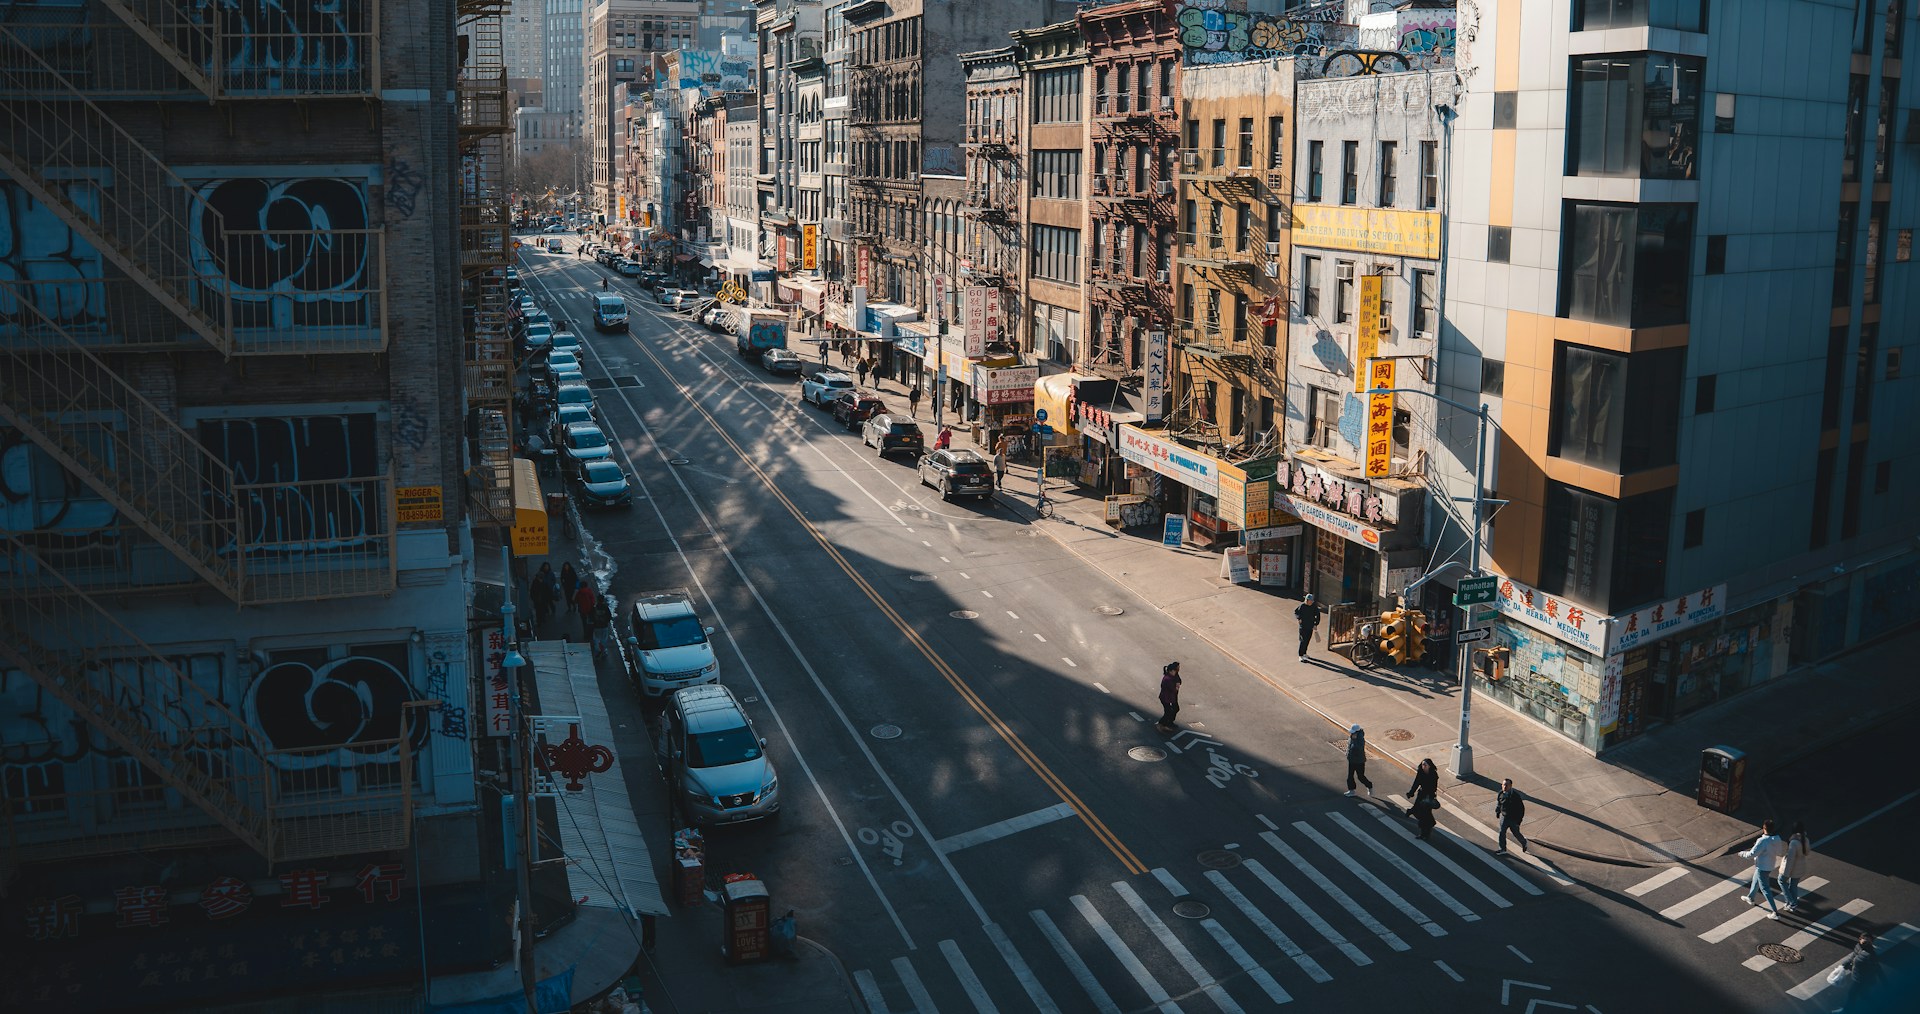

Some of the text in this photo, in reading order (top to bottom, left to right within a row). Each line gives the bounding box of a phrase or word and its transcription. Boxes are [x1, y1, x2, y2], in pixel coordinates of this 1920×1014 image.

[1337, 227, 1368, 238] DRIVING
[1372, 231, 1403, 241] SCHOOL
[404, 488, 432, 497] RIGGER
[1306, 505, 1326, 519] GARDEN
[1326, 513, 1358, 534] RESTAURANT
[1461, 581, 1494, 591] Manhattan
[1513, 602, 1521, 613] DA
[1526, 608, 1552, 626] HERBAL
[1557, 622, 1590, 641] MEDICINE
[1620, 631, 1638, 645] KANG
[1641, 628, 1650, 637] DA
[1656, 616, 1681, 632] HERBAL
[1688, 605, 1716, 620] MEDICINE
[1461, 633, 1470, 641] ONE
[1704, 784, 1719, 796] LOVE
[736, 936, 756, 947] LOVE
